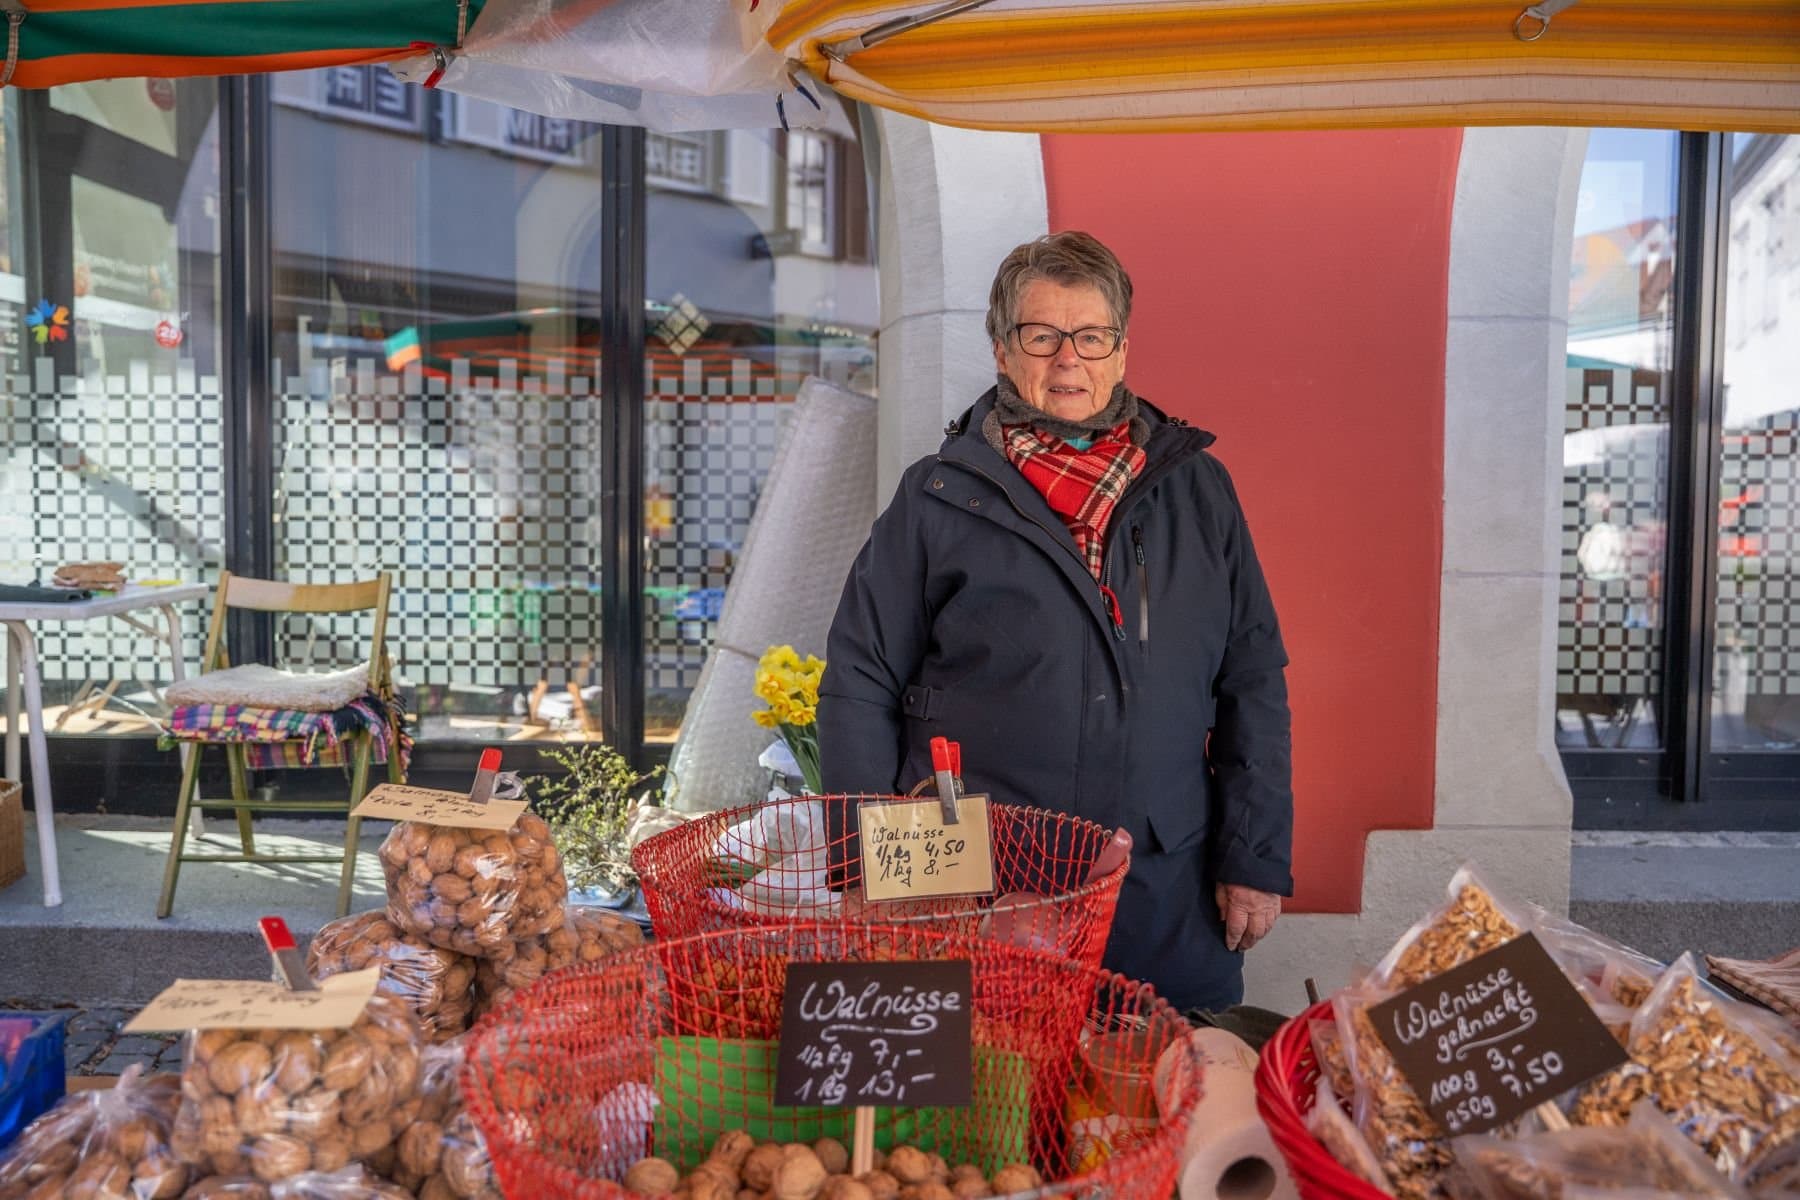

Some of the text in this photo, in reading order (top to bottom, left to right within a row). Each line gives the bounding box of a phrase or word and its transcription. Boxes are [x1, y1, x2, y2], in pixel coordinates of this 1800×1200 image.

[871, 823, 945, 844] Walnüsse
[924, 839, 965, 857] 4,50
[799, 979, 961, 1021] Walnüsse
[1393, 966, 1514, 1045] Walnüsse
[1435, 981, 1534, 1065] geknackt
[794, 1077, 813, 1102] 1
[1500, 1049, 1564, 1098] 7,50
